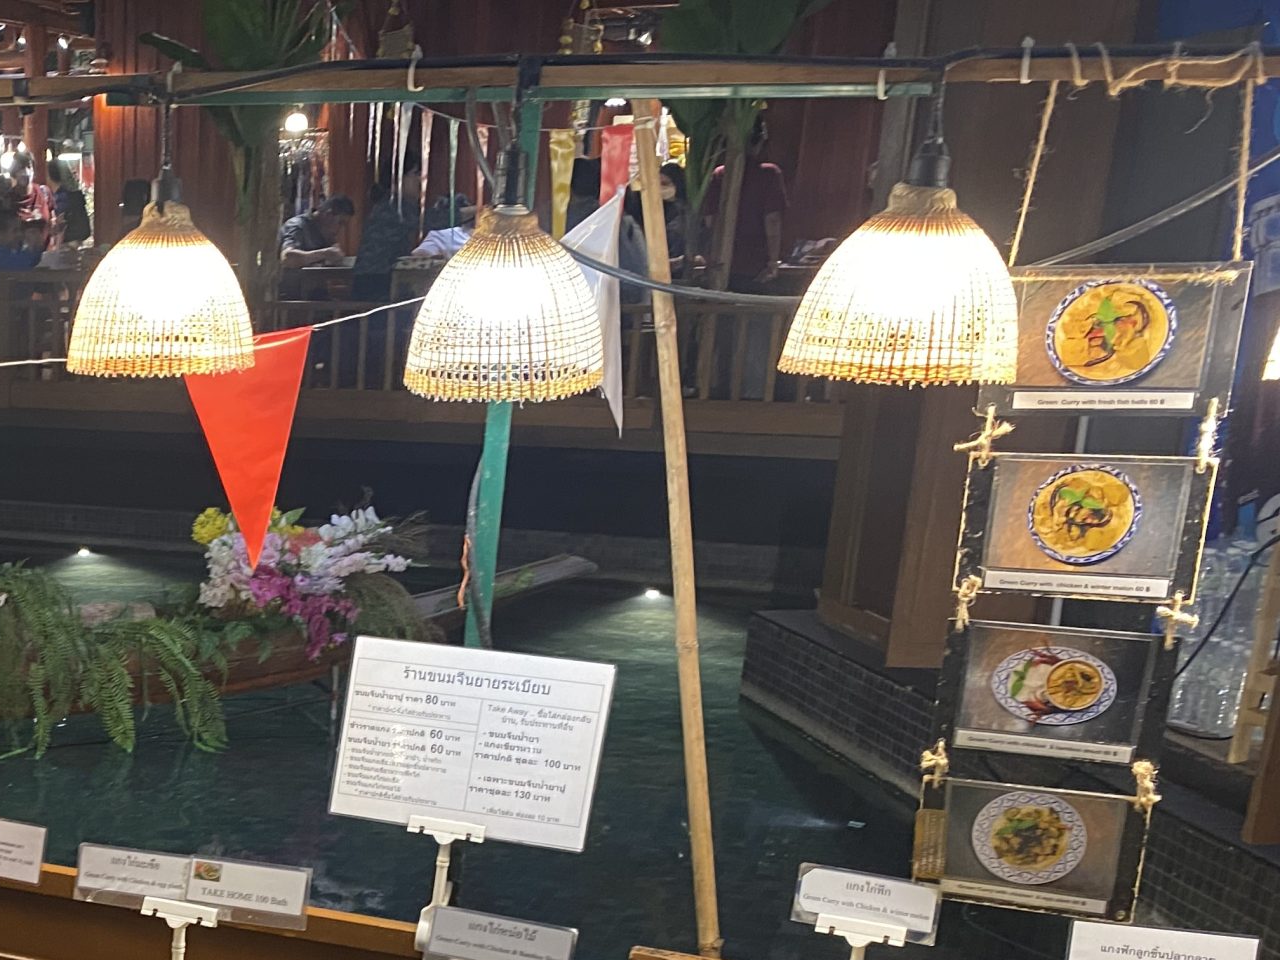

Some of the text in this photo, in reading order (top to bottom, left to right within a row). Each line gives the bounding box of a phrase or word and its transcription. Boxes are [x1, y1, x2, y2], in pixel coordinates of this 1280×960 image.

[403, 665, 551, 695] ร้านขนมจีนยายระเบียบ
[425, 695, 438, 705] 80
[488, 704, 528, 717] Take Away
[430, 729, 443, 739] 60
[430, 744, 444, 754] 60
[544, 759, 561, 769] 100
[563, 763, 581, 771] บาท
[514, 789, 531, 800] 130
[533, 794, 551, 802] บาท
[201, 886, 224, 897] TAKE
[226, 889, 254, 902] HOME
[822, 896, 840, 906] Curry
[841, 900, 855, 908] with
[856, 902, 881, 913] Chicken
